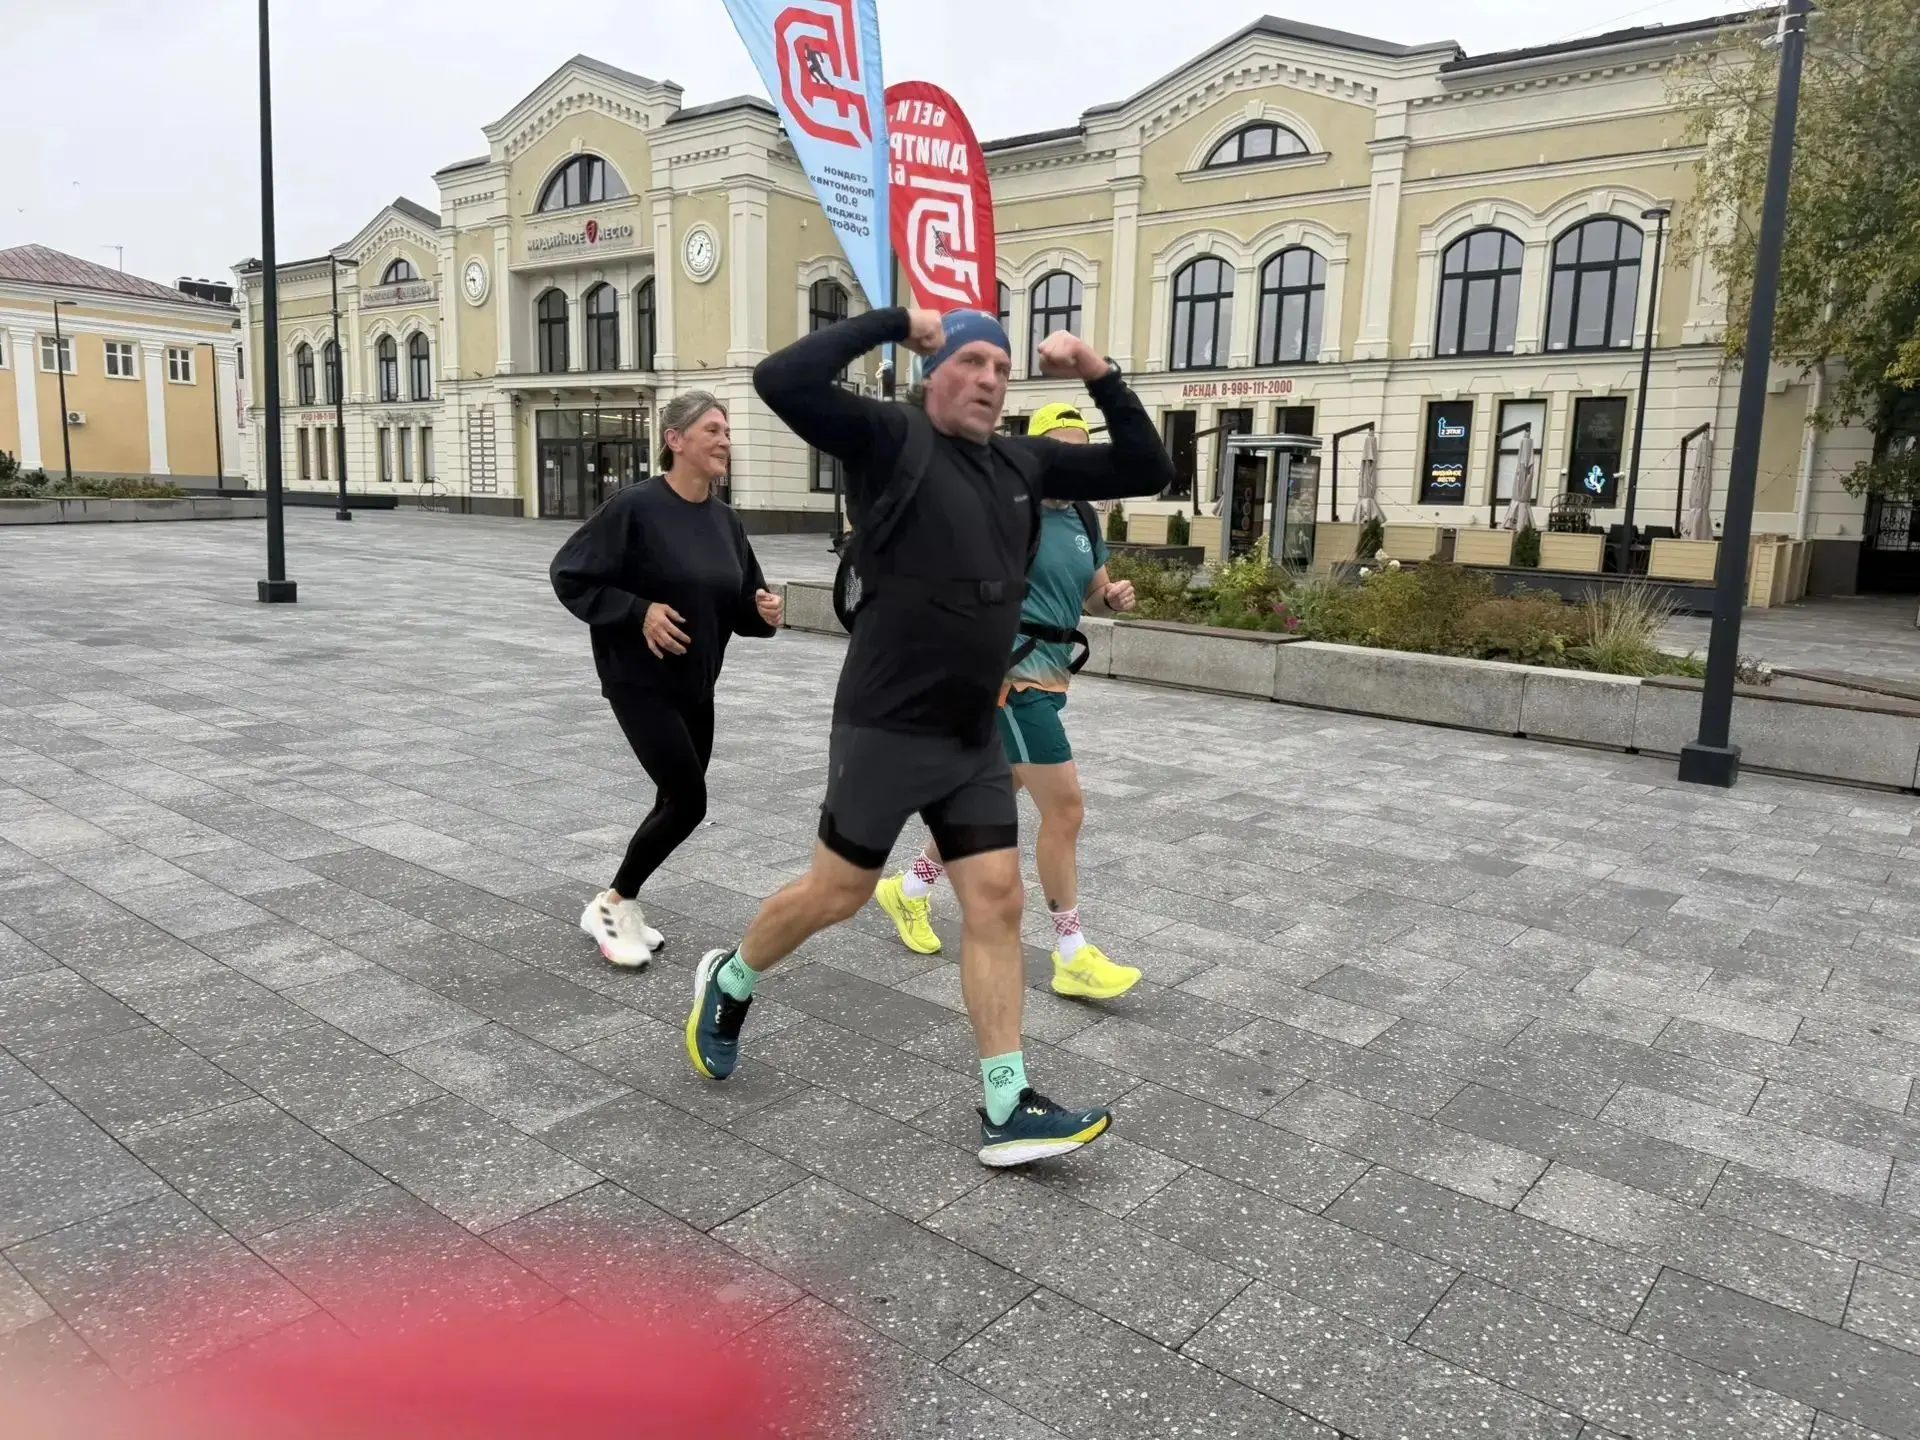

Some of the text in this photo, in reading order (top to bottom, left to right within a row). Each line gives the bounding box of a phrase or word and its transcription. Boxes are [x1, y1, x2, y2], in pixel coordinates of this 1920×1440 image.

[527, 231, 586, 252] МИДИЙНОЕ
[1182, 380, 1293, 398] АРЕНДА 8-999-111-2000
